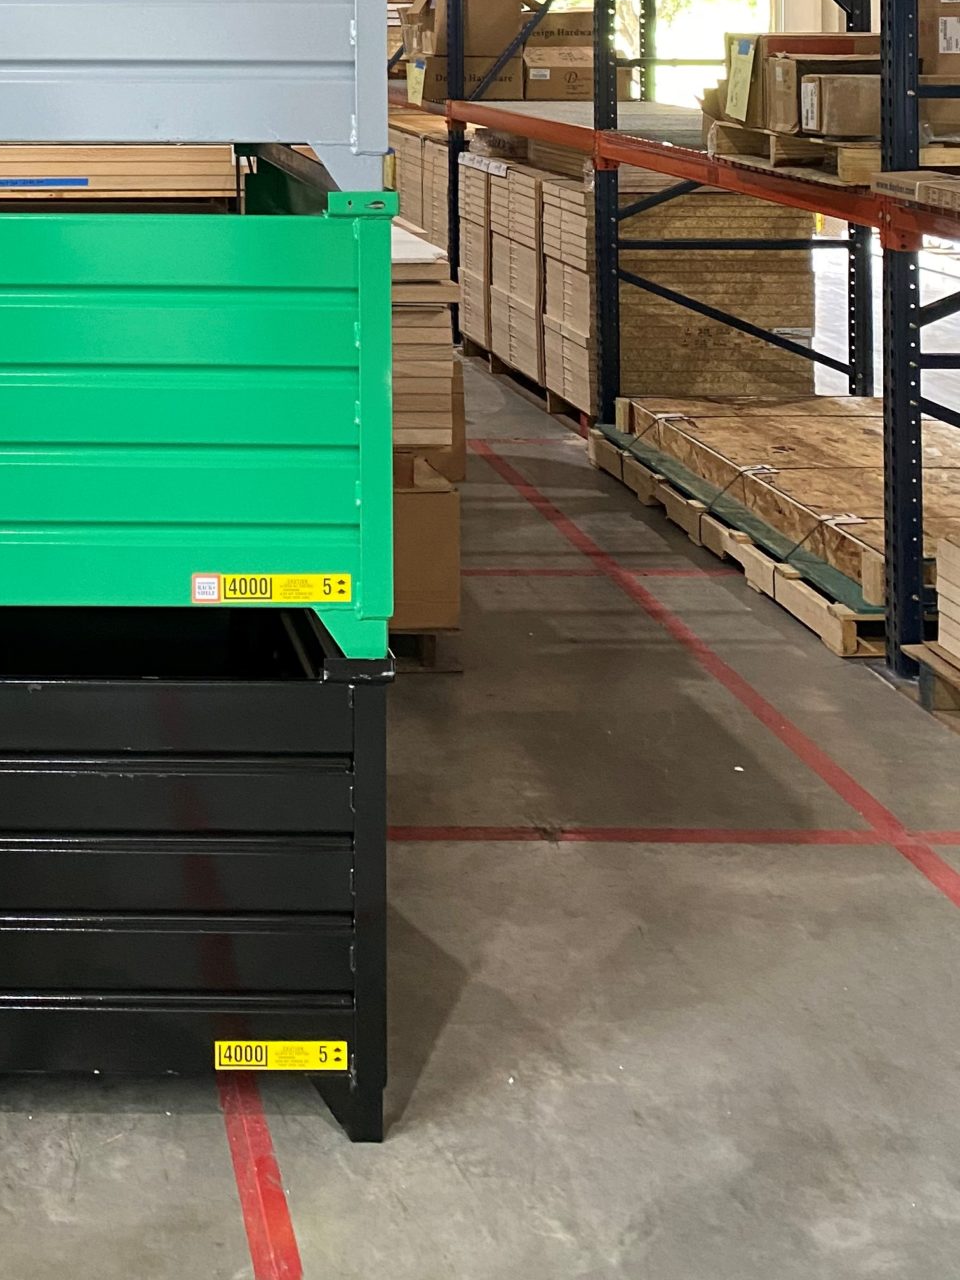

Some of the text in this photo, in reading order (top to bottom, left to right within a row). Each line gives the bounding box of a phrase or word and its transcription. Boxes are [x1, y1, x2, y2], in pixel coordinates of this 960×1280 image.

[529, 27, 593, 40] esign Hardwa
[469, 73, 513, 82] Haare
[228, 577, 269, 596] 4000
[322, 577, 332, 596] 5
[223, 1044, 263, 1063] 4000
[318, 1045, 328, 1063] 5
